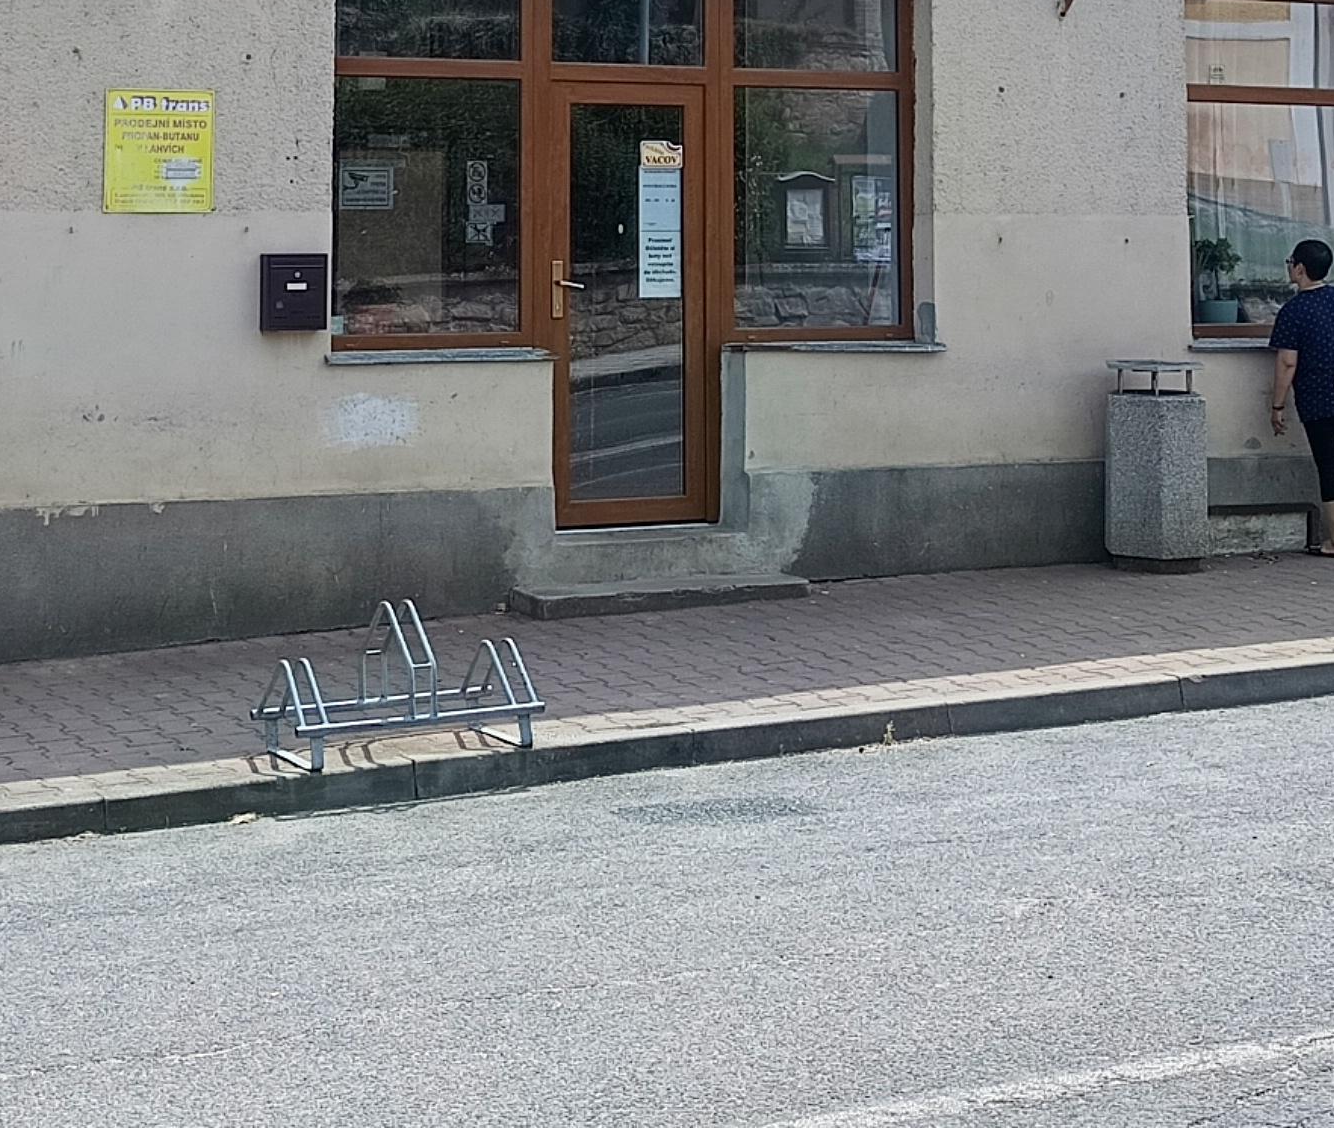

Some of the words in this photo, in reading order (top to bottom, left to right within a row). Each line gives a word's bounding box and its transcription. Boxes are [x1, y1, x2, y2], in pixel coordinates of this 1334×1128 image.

[130, 95, 157, 111] PB
[162, 97, 210, 112] trans
[114, 117, 170, 128] PRODEJNÍ
[173, 118, 207, 129] MÍSTO
[645, 155, 677, 164] VACOV
